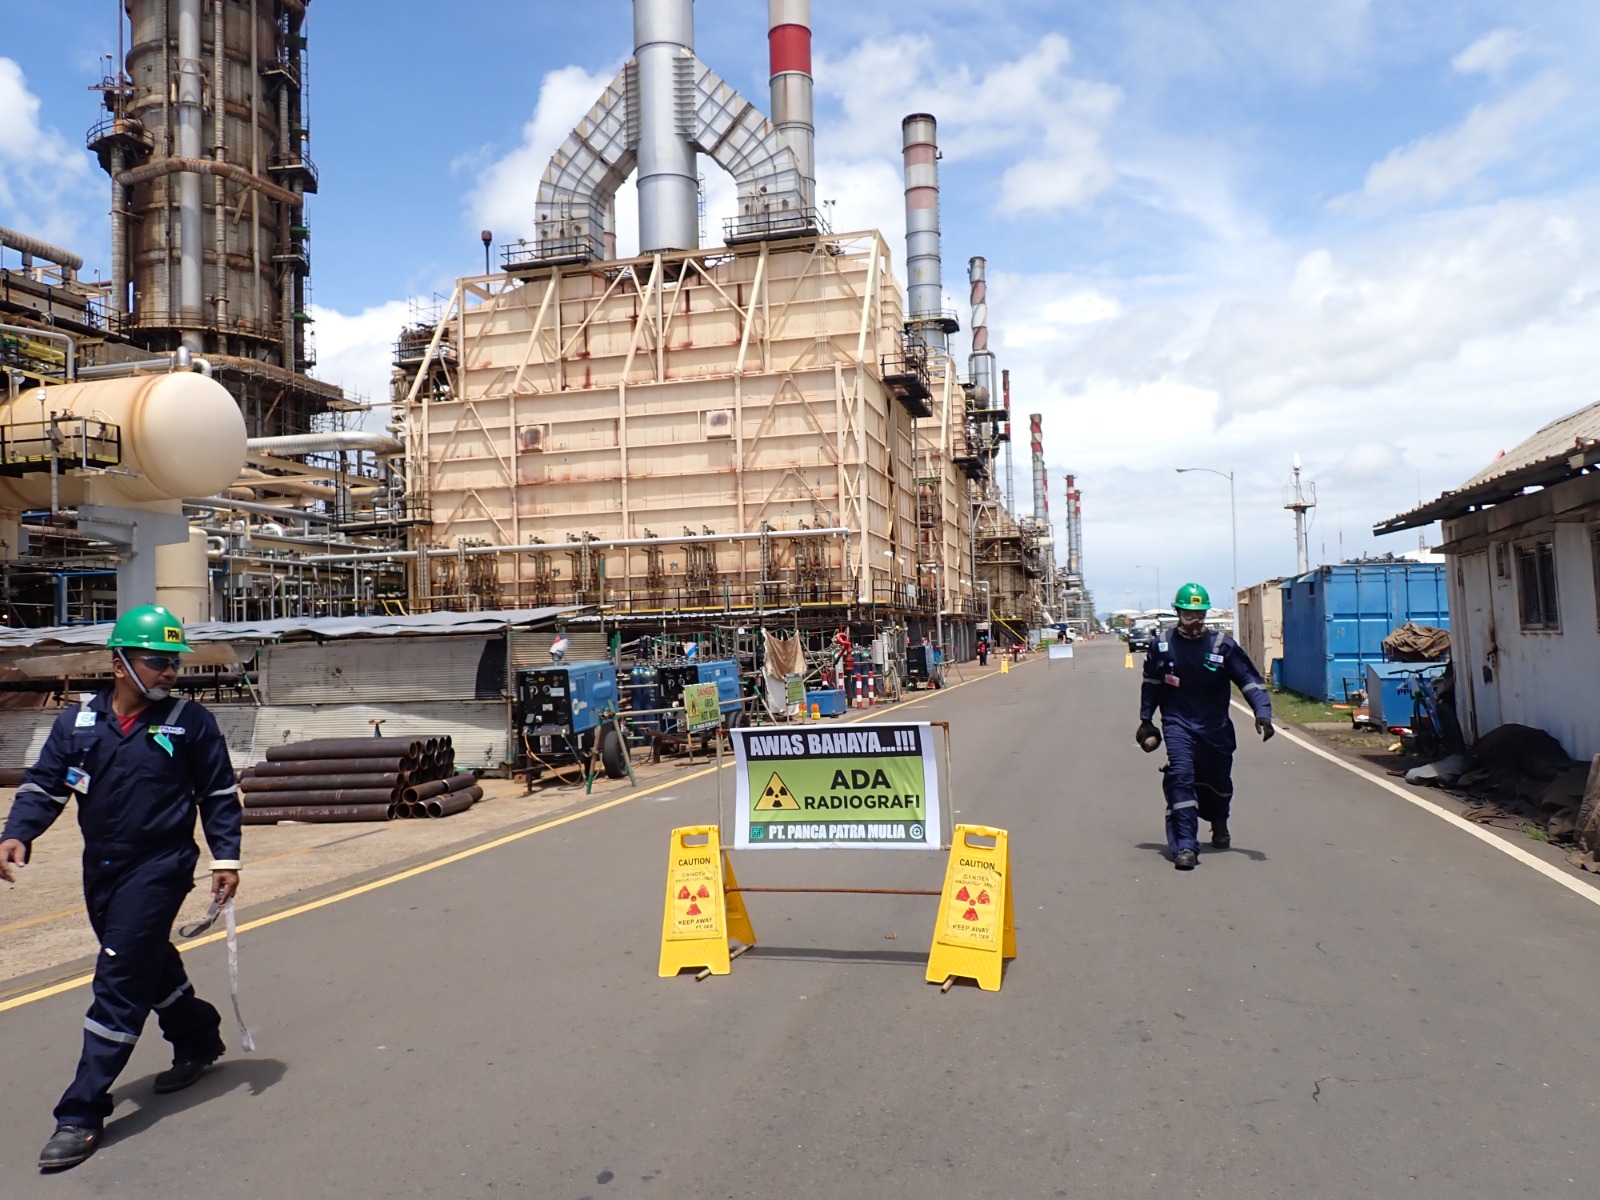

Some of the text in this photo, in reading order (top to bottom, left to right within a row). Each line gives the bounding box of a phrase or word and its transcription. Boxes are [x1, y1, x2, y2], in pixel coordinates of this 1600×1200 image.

[697, 686, 715, 697] DANGER
[750, 730, 917, 756] AWAS BAHAYA...!!!
[830, 769, 891, 790] ADA
[804, 794, 920, 810] RADIOGRAFI
[768, 824, 906, 839] PT. PANCA PATRA MULIA
[678, 857, 711, 867] CAUTION
[959, 858, 996, 870] CAUTION
